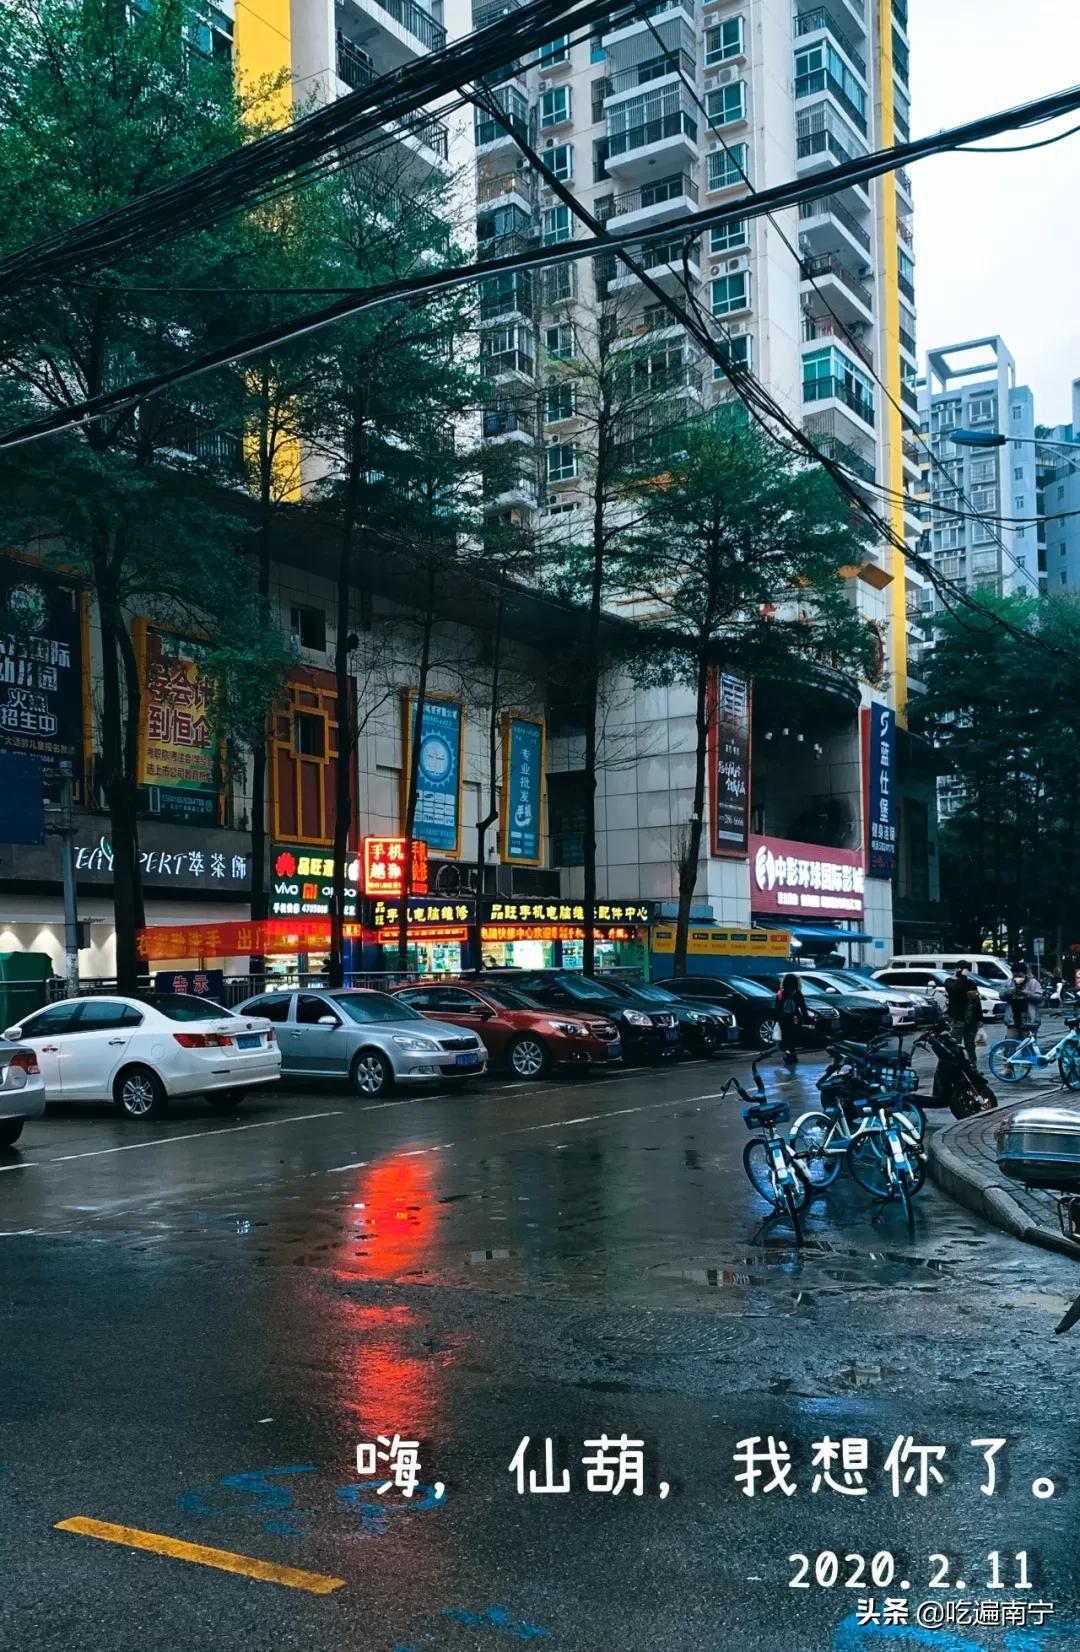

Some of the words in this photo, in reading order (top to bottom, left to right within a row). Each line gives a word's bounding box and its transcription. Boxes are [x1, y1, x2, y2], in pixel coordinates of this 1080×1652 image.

[0, 706, 57, 732] 招生中
[147, 705, 215, 749] 到恒企
[369, 844, 404, 860] 手机
[274, 882, 299, 896] vivo
[386, 904, 469, 924] 手电脑维修
[490, 903, 648, 922] 品旺手机电脑维配件中心
[172, 976, 210, 995] 告示
